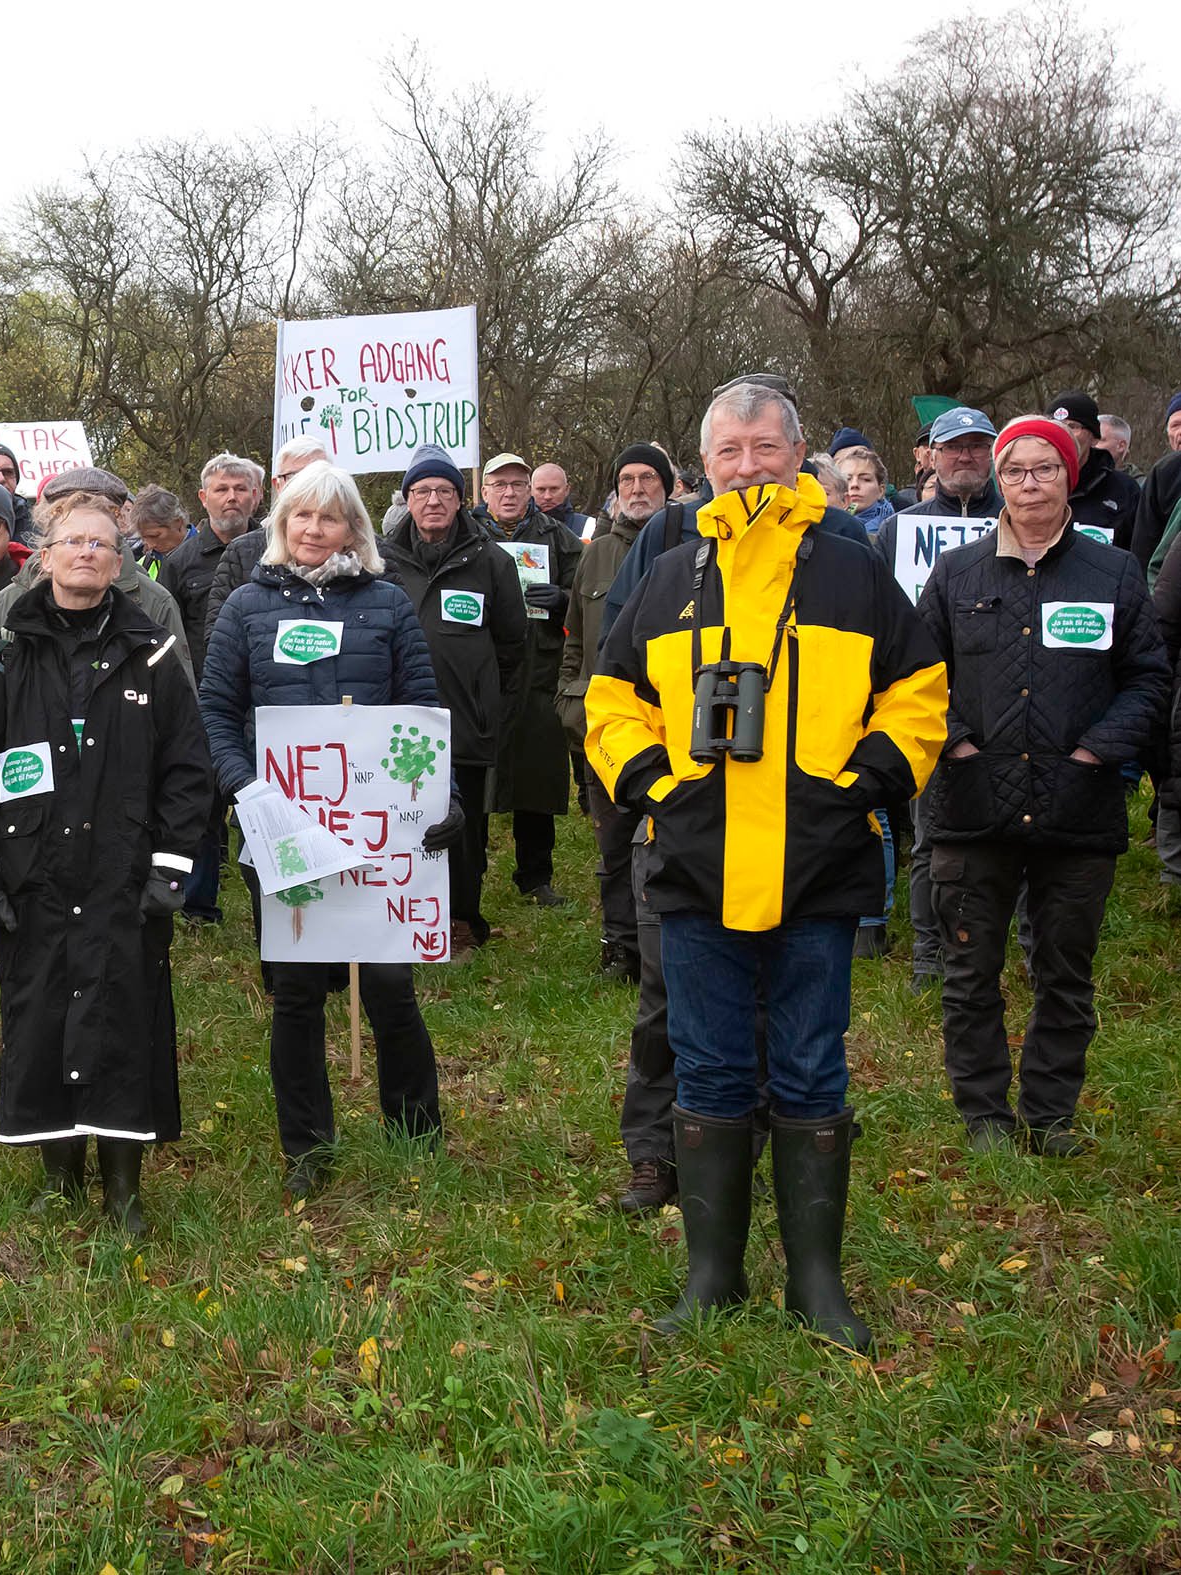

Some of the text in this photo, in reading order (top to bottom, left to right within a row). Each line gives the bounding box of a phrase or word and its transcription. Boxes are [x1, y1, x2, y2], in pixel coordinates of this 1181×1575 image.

[282, 338, 451, 397] KKER ADGANG
[337, 387, 373, 404] FOR
[13, 428, 78, 451] TAK
[353, 400, 476, 455] BIDSTRUP
[266, 743, 348, 806] NEJ
[354, 771, 375, 784] NNP
[399, 810, 424, 824] NNP
[422, 850, 443, 862] NNP
[386, 895, 440, 928] NEJ
[412, 931, 447, 961] NEJ
